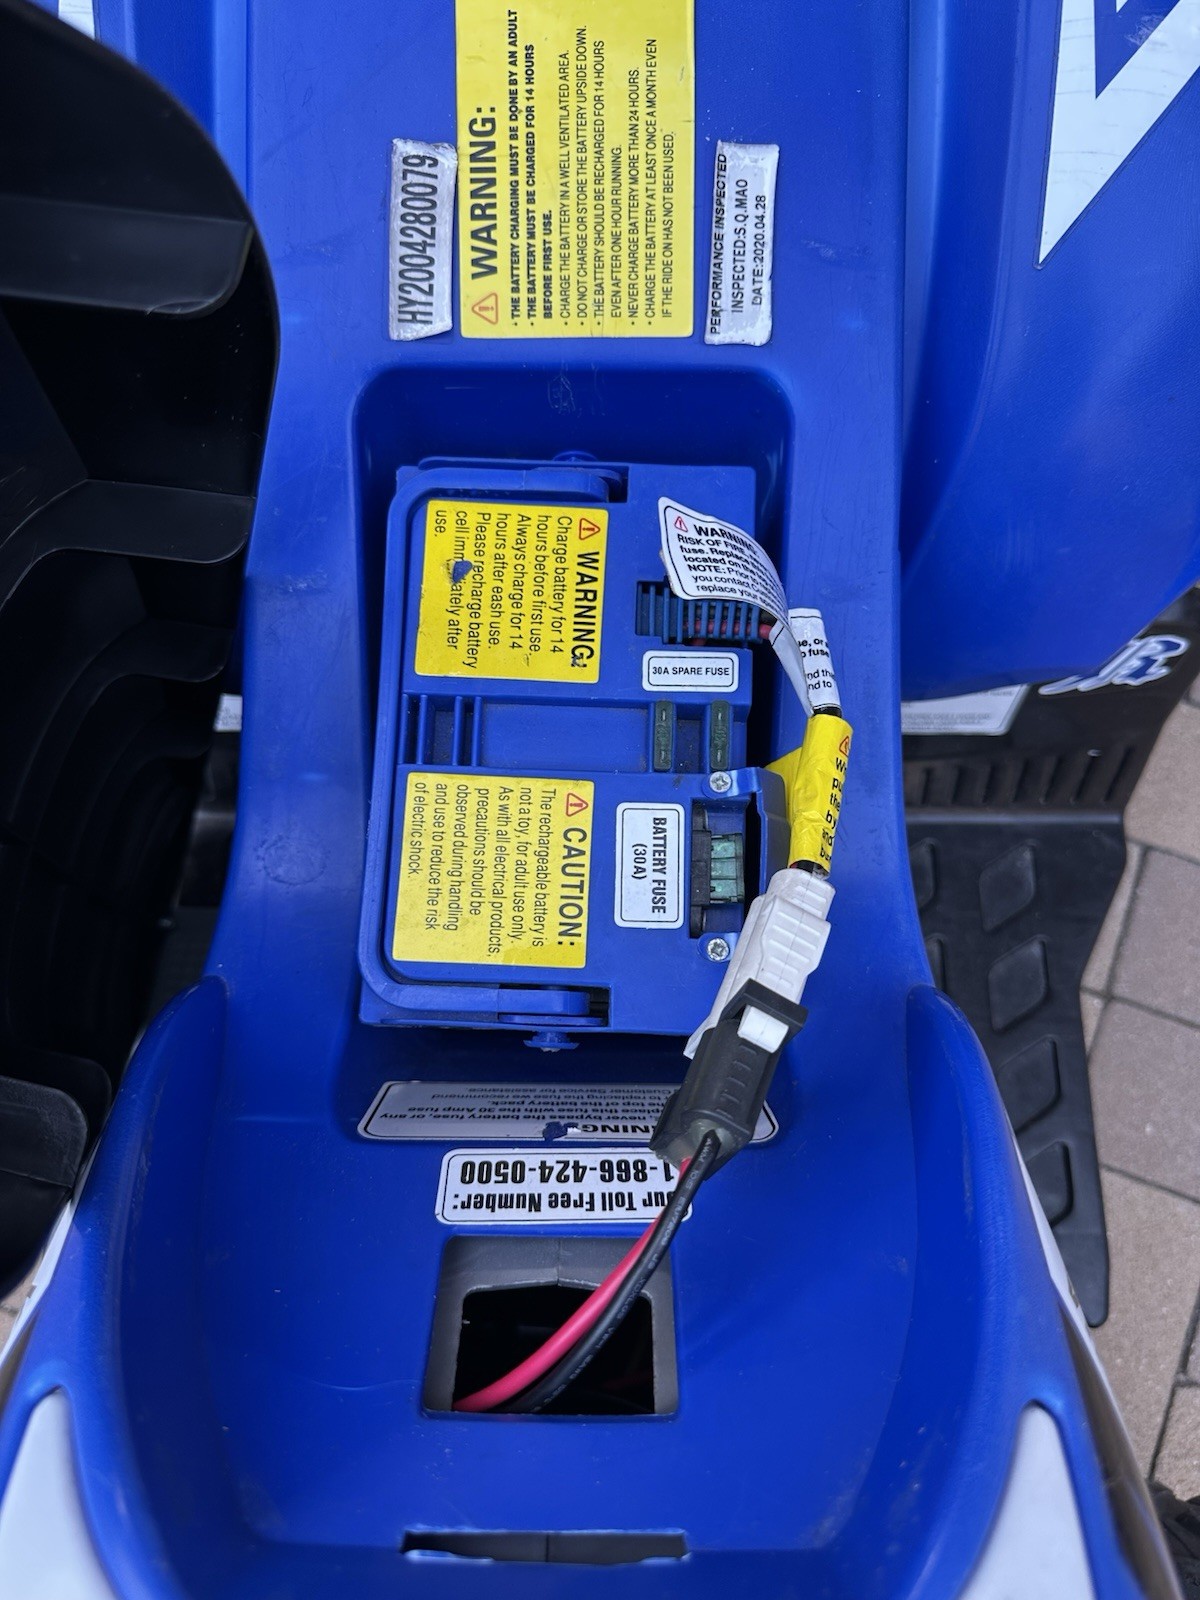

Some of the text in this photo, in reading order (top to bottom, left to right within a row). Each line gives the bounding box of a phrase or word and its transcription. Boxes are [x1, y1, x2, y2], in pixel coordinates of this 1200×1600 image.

[645, 38, 656, 67] EVEN
[645, 69, 656, 108] MONTH
[645, 119, 656, 149] ONCE
[507, 9, 520, 319] THE BATTERY CHARGING MUST BE DONE BY AN ADULT
[575, 25, 587, 317] DO NOT CHARGE OR STORE THE BATTERY UPSIDE DOWN.
[645, 151, 656, 184] LEAST
[468, 106, 497, 280] WARNING:
[524, 44, 536, 319] THE BATTERY MUST BE CHARGED FOR 14 HOURS
[558, 49, 570, 318] CHARGE THE BATTERY IN A WELL VENTILATED AREA.
[645, 186, 655, 200] AT
[397, 154, 438, 324] HY2004280079
[645, 201, 656, 249] BATTERY
[661, 131, 673, 317] IF THE RIDE ON HAS NOT BEEN USED.
[710, 153, 726, 333] PERFORMANCE INSPECTED
[751, 194, 766, 305] DATE:2020.04.28
[542, 209, 552, 318] BEFORE FIRST USE.
[644, 251, 655, 272] THE
[644, 274, 655, 317] CHARGE
[434, 509, 446, 536] use.
[455, 510, 469, 533] cell
[677, 534, 706, 546] RISK
[706, 538, 722, 547] OF
[679, 545, 709, 554] fuse.
[683, 555, 742, 569] located on
[687, 564, 727, 575] NOTE:
[462, 512, 491, 668] Please recharge battery
[487, 512, 511, 648] hours after eash use.
[507, 513, 531, 649] Always charge for 14
[528, 515, 551, 655] hours before first use.
[548, 515, 572, 653] Charge battery for 14
[692, 575, 752, 589] you contact
[696, 584, 738, 594] replace
[446, 618, 462, 649] after
[652, 666, 729, 675] 30A SPARE FUSE
[498, 786, 514, 801] As
[518, 787, 532, 805] not
[407, 782, 429, 877] of electric shock.
[496, 803, 512, 826] with
[513, 817, 531, 838] toy,
[469, 788, 490, 915] precautions should be
[495, 829, 510, 842] all
[516, 841, 532, 857] for
[425, 783, 449, 930] and use to reduce the risk
[443, 784, 471, 931] observed during handling
[491, 845, 509, 898] electrical
[530, 788, 556, 946] The rechargeable battery is
[631, 843, 647, 879] (30A)
[651, 817, 666, 913] BATTERY FUSE
[513, 859, 529, 888] adult
[557, 827, 587, 946] CAUTION:
[512, 891, 524, 912] use
[507, 915, 526, 943] only.
[468, 1113, 520, 1121] battery
[460, 1159, 675, 1183] 1-866-424-0500
[452, 1192, 541, 1212] Number:
[547, 1192, 594, 1211] Free
[601, 1191, 636, 1211] Toll
